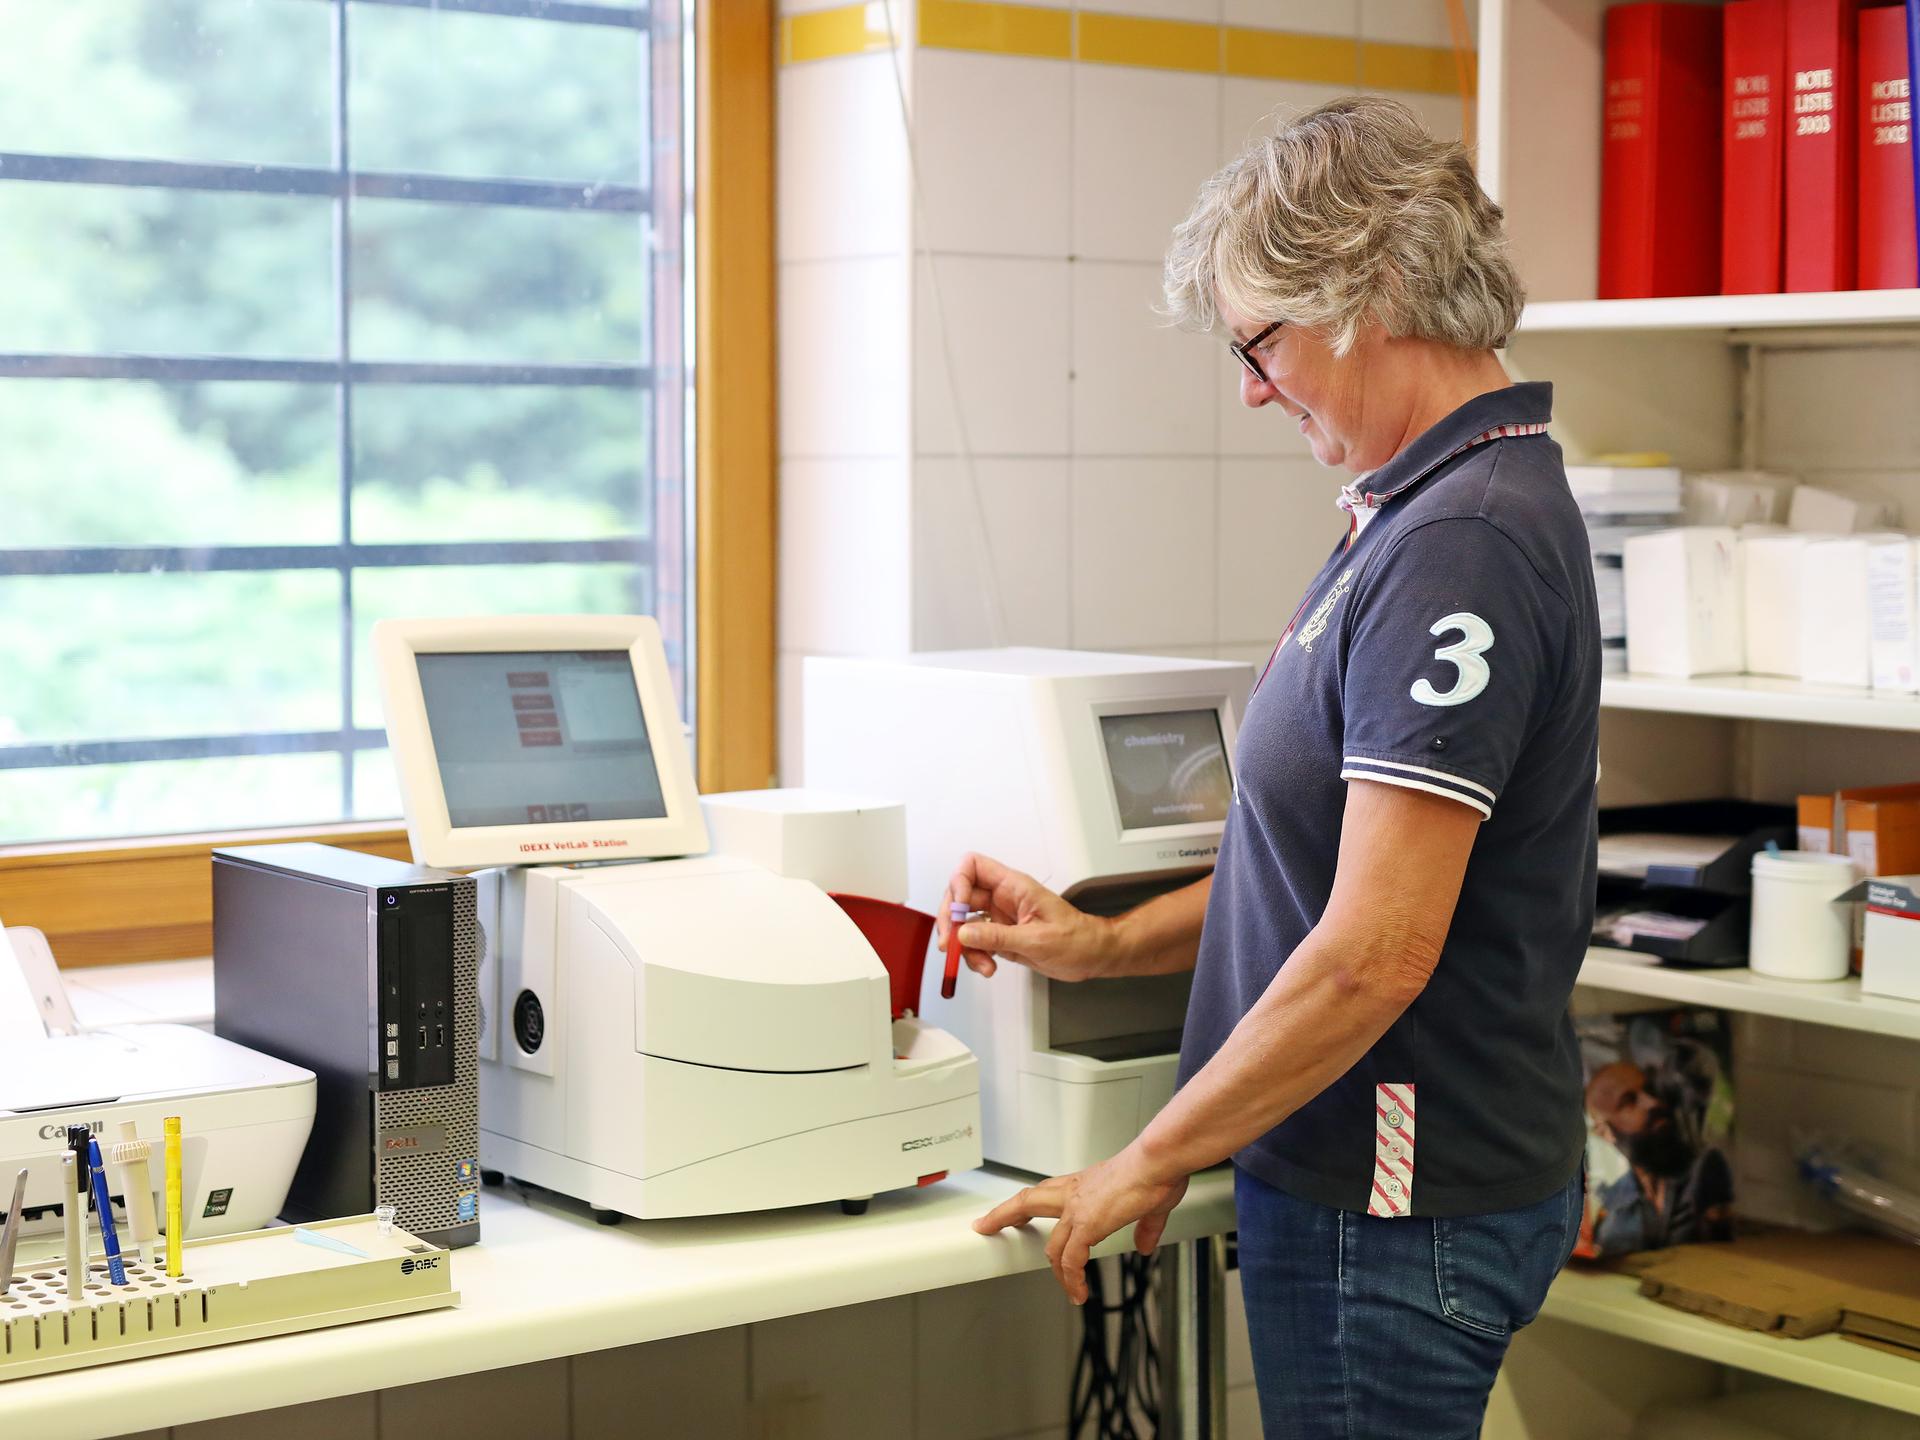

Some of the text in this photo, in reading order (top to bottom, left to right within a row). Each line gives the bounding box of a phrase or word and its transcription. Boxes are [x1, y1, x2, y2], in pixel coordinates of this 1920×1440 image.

[1795, 69, 1832, 90] ROTE
[1871, 79, 1910, 99] ROTE
[1794, 91, 1833, 114] LISTE
[1871, 101, 1911, 123] LISTE
[1410, 612, 1495, 707] 3
[1124, 732, 1184, 748] chemistry
[519, 839, 628, 852] IDEXX VetLab Station
[1178, 848, 1211, 858] Catalyst
[386, 1137, 417, 1150] DELL
[416, 1257, 438, 1270] QBC
